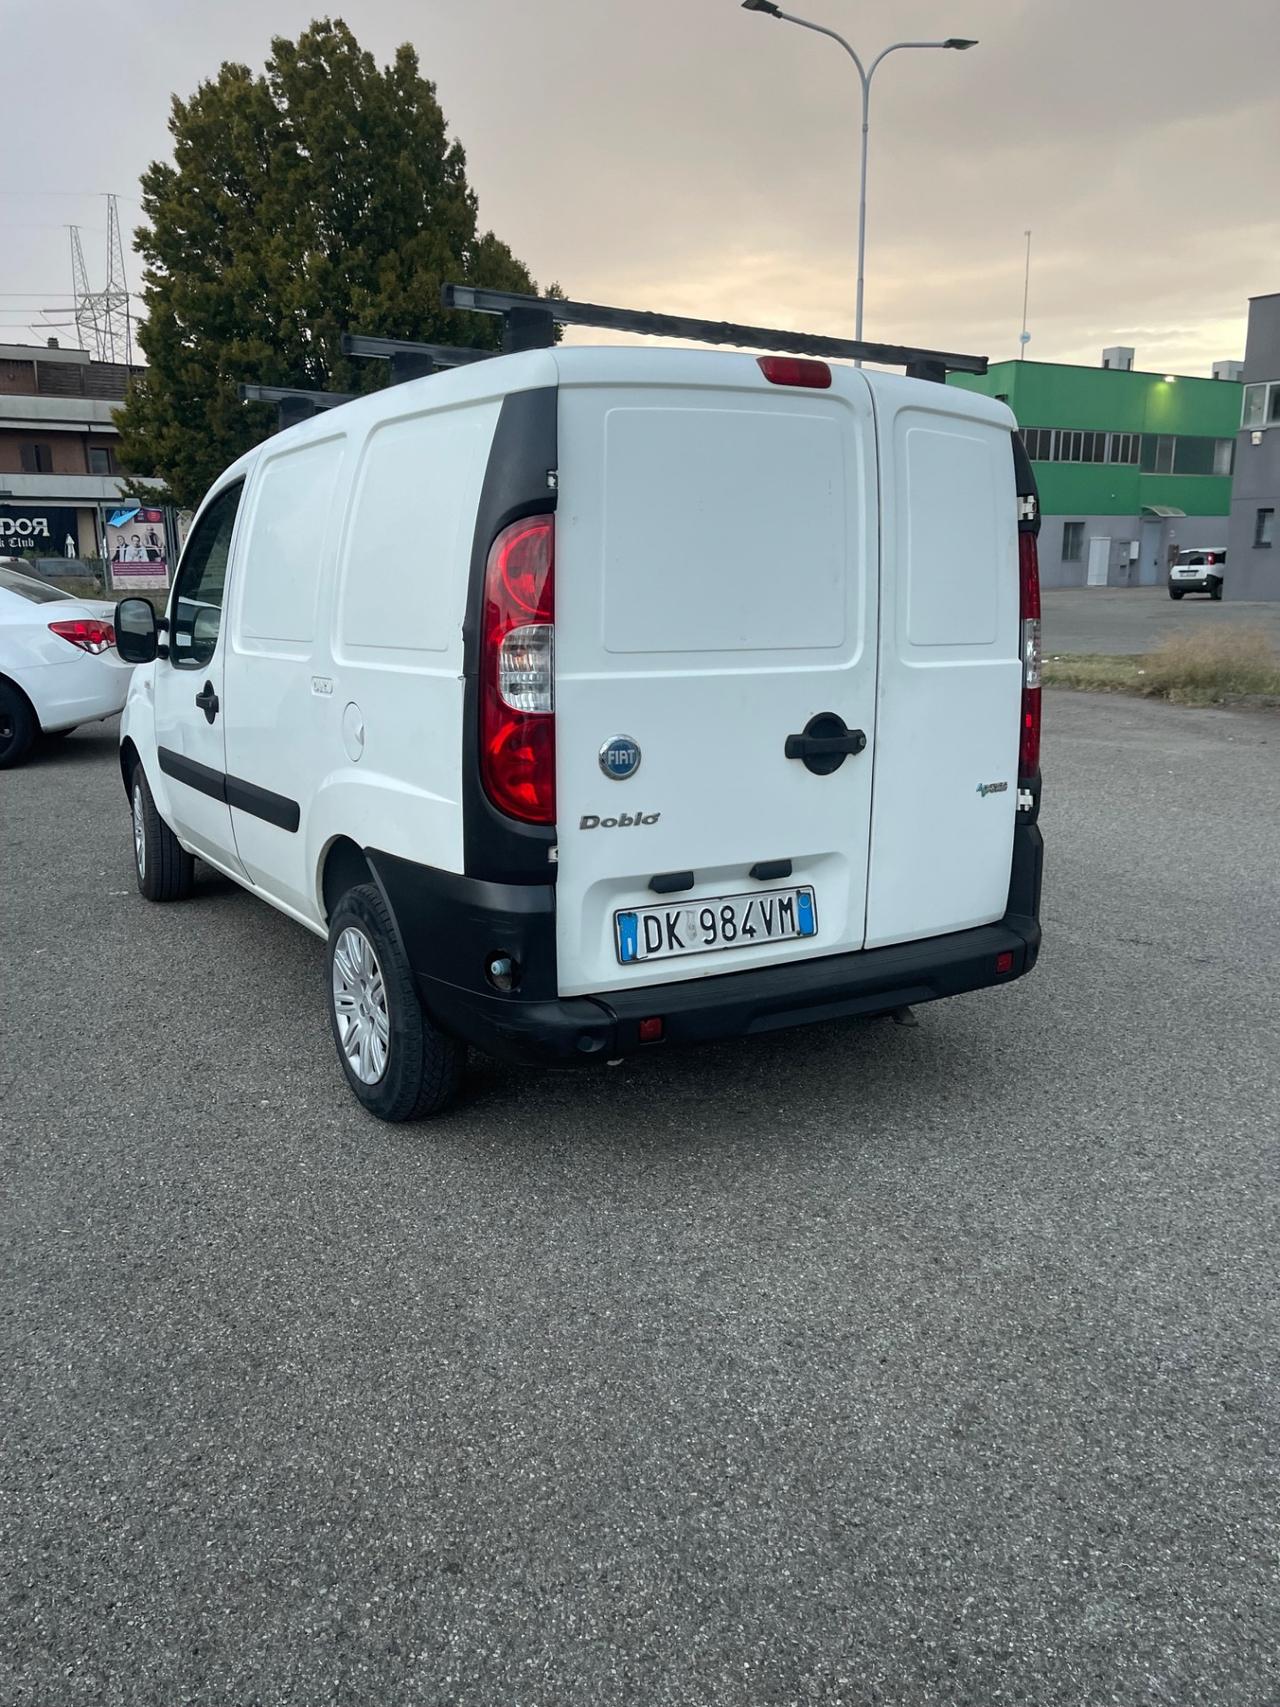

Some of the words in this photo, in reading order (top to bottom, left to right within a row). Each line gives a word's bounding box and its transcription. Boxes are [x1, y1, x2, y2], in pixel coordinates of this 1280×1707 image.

[8, 537, 35, 548] Club
[607, 749, 635, 765] FIAT
[643, 911, 685, 954] DK
[699, 896, 797, 945] 984VM
